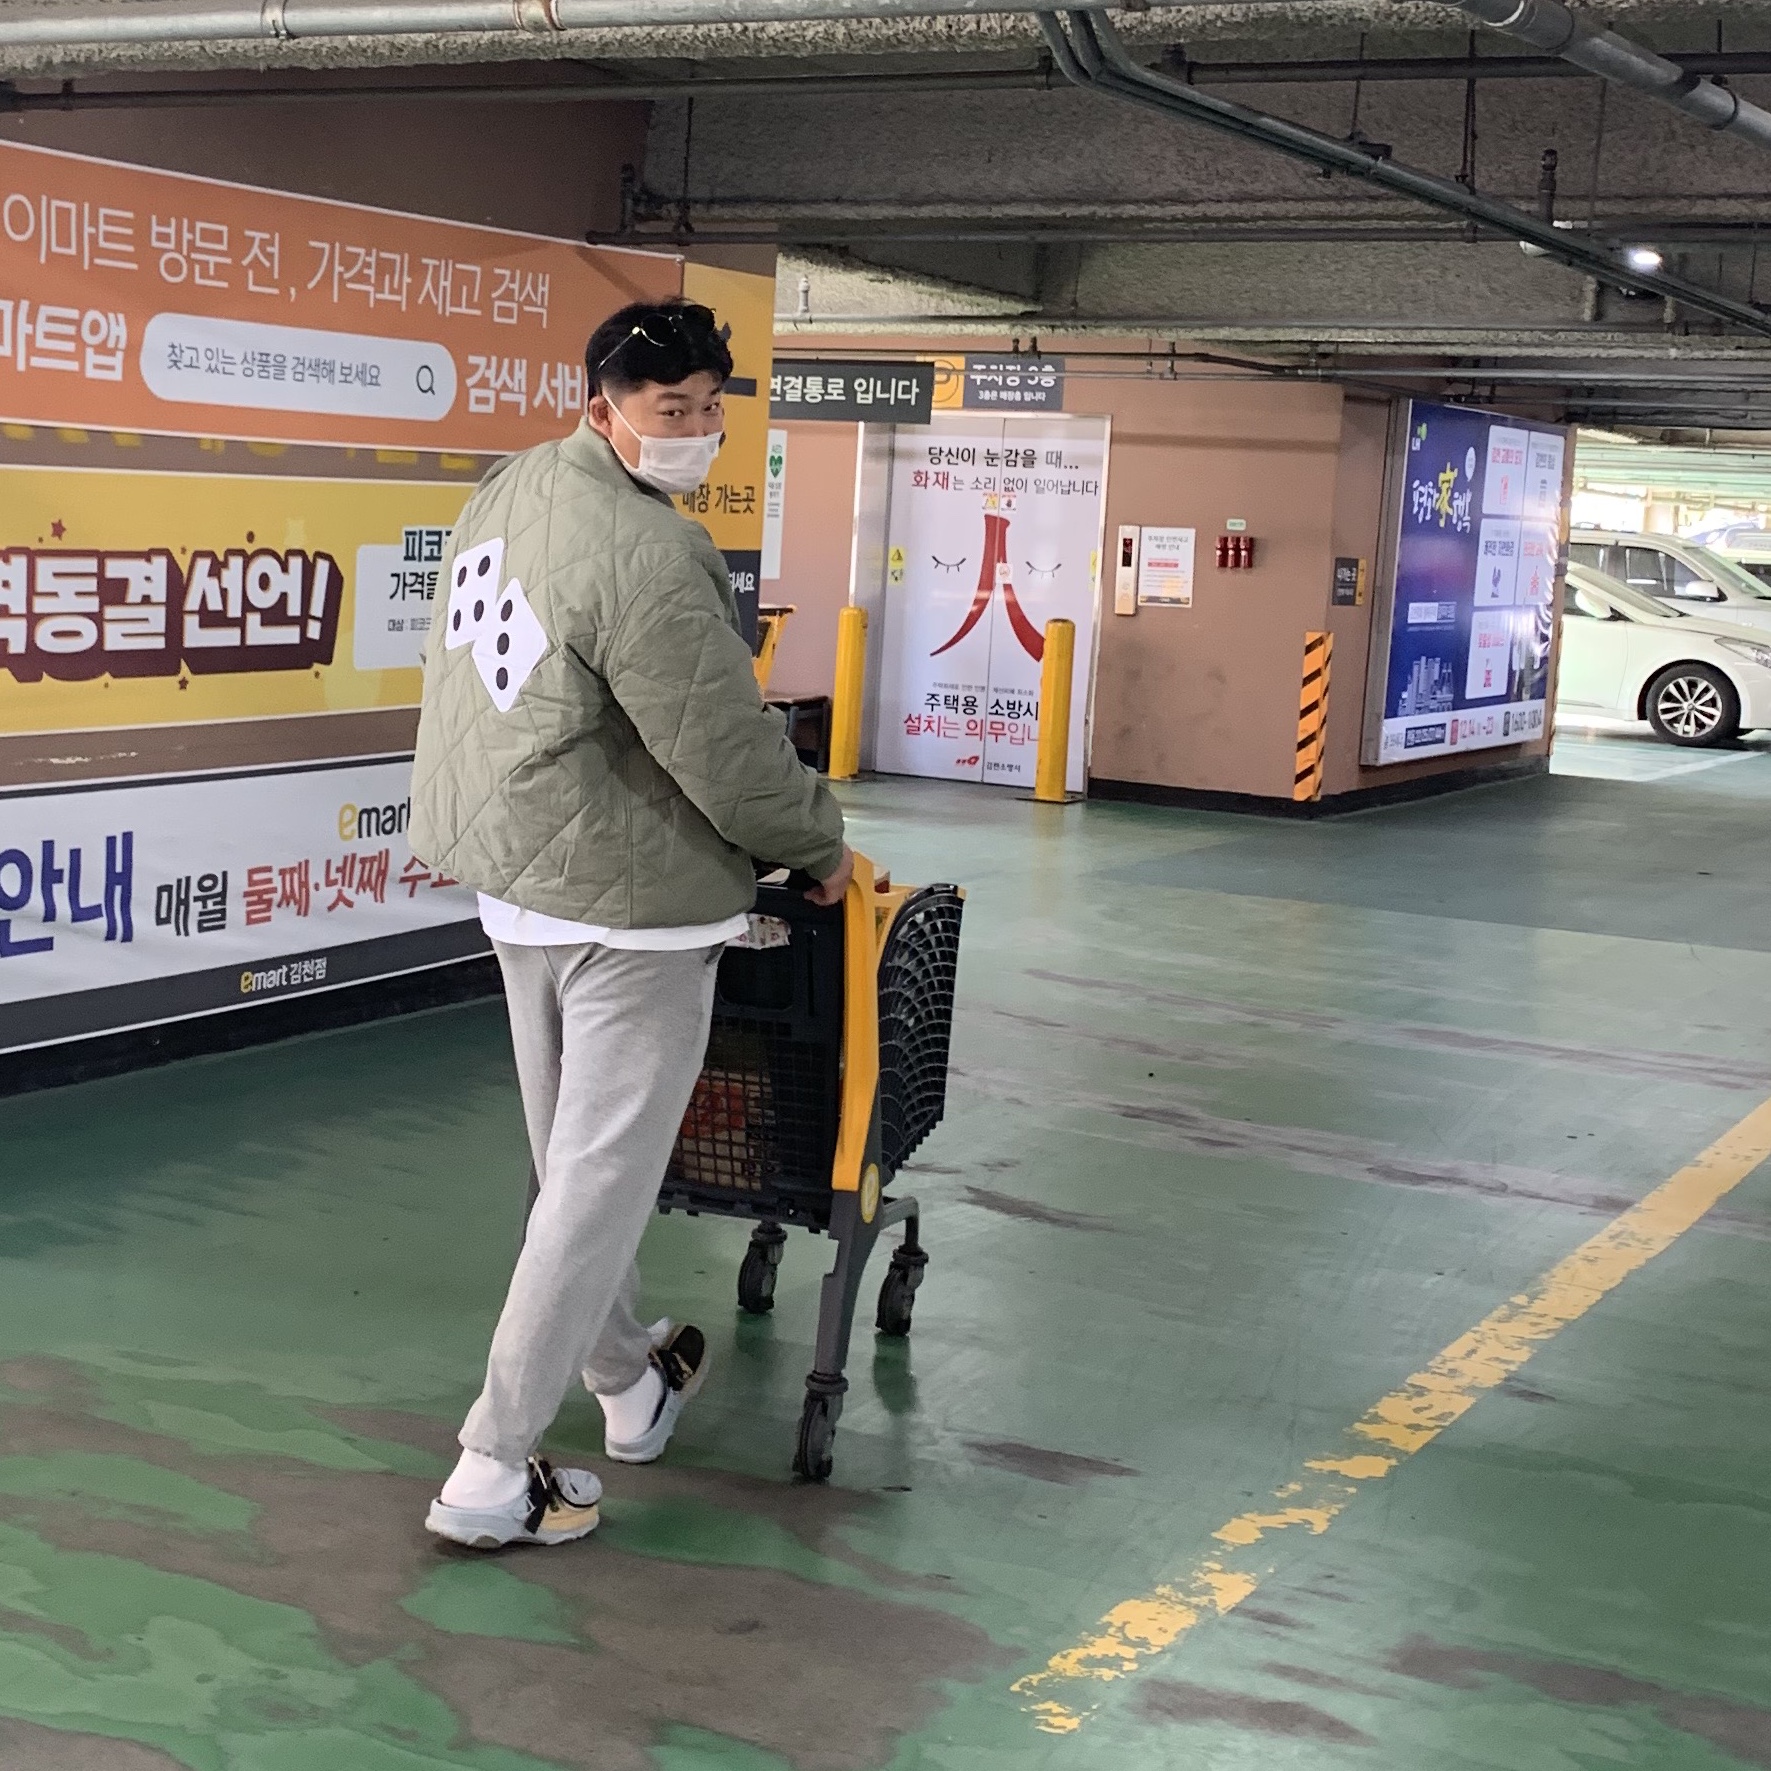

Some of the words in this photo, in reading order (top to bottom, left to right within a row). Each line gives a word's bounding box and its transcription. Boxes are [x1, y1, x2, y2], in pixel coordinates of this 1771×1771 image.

[3, 194, 139, 270] 이마트
[150, 214, 232, 288] 방문
[307, 240, 412, 312] 가격과
[418, 257, 482, 317] 재고
[491, 267, 550, 329] 검색
[167, 342, 200, 371] 찾고
[205, 347, 236, 376] 있는
[240, 351, 287, 381] 상품을
[291, 356, 335, 385] 검색해
[338, 361, 381, 387] 보세요
[465, 355, 527, 416] 검색
[853, 378, 919, 406] 입니다
[928, 446, 976, 466] 당신이
[911, 469, 964, 491] 화재는
[970, 477, 996, 492] 소리
[1003, 478, 1028, 494] 없이
[1033, 478, 1099, 496] 일어납니다
[715, 484, 755, 515] 가는곳
[403, 530, 452, 562] 피코
[183, 555, 330, 649] 선언!
[924, 693, 979, 715] 주택용
[904, 713, 960, 739] 설치는
[0, 831, 134, 958] 안내
[155, 870, 228, 937] 매월
[240, 965, 288, 993] emart
[289, 957, 327, 985] 김천점
